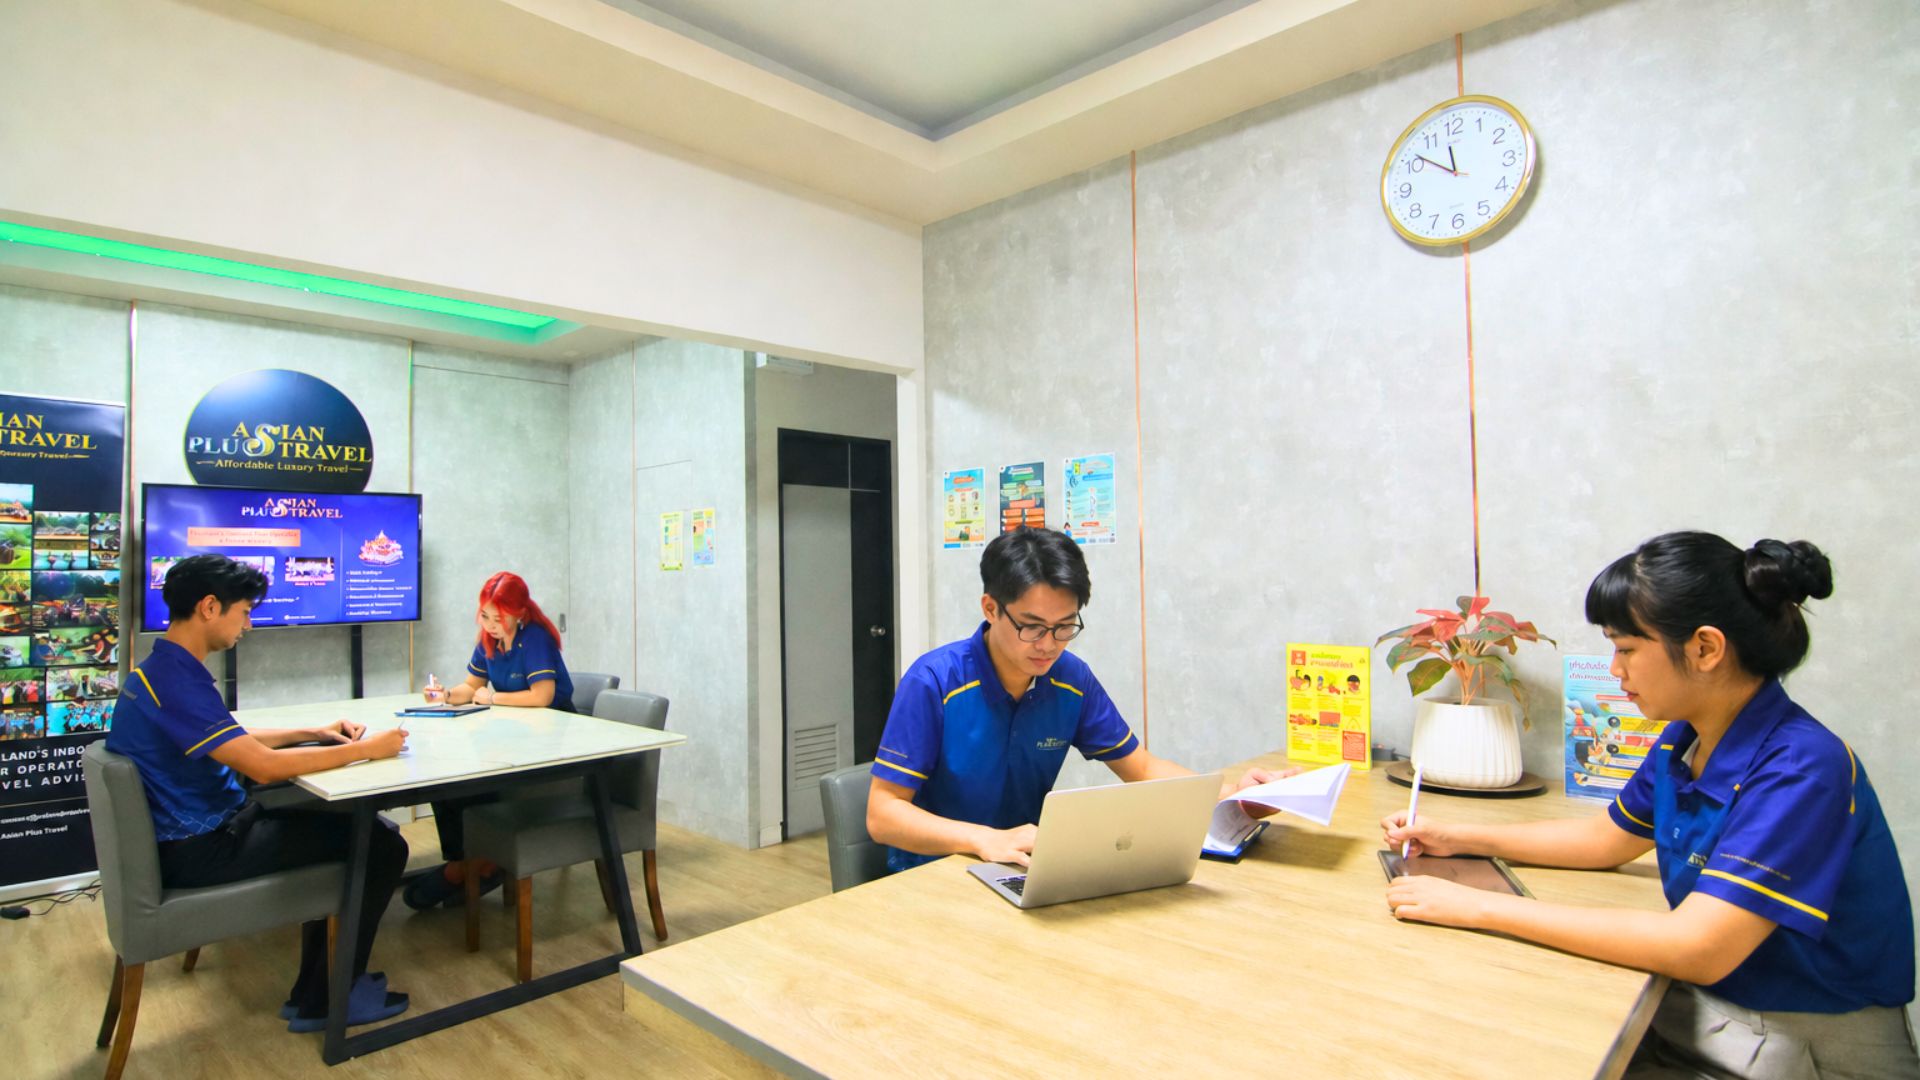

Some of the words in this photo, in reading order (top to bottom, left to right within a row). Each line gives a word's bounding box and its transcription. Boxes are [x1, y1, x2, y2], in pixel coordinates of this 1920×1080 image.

[1444, 117, 1464, 137] 12
[1475, 117, 1483, 133] 1
[1424, 132, 1439, 150] 11
[1492, 127, 1506, 145] 2
[1405, 156, 1425, 175] 10
[1502, 149, 1517, 167] 3
[1399, 182, 1412, 199] 9
[1494, 175, 1509, 192] 4
[1409, 202, 1422, 219] 8
[1477, 200, 1491, 216] 5
[1429, 213, 1440, 230] 7
[1451, 213, 1465, 230] 6
[0, 428, 97, 450] TRAVEL
[232, 421, 326, 446] ASIAN
[187, 430, 276, 457] PLUS
[278, 440, 372, 464] TRAVEL
[214, 458, 275, 470] Affordable
[277, 461, 313, 473] Luxury
[317, 463, 349, 474] Travel
[290, 506, 343, 519] TRAVEL
[2, 778, 32, 790] VEL
